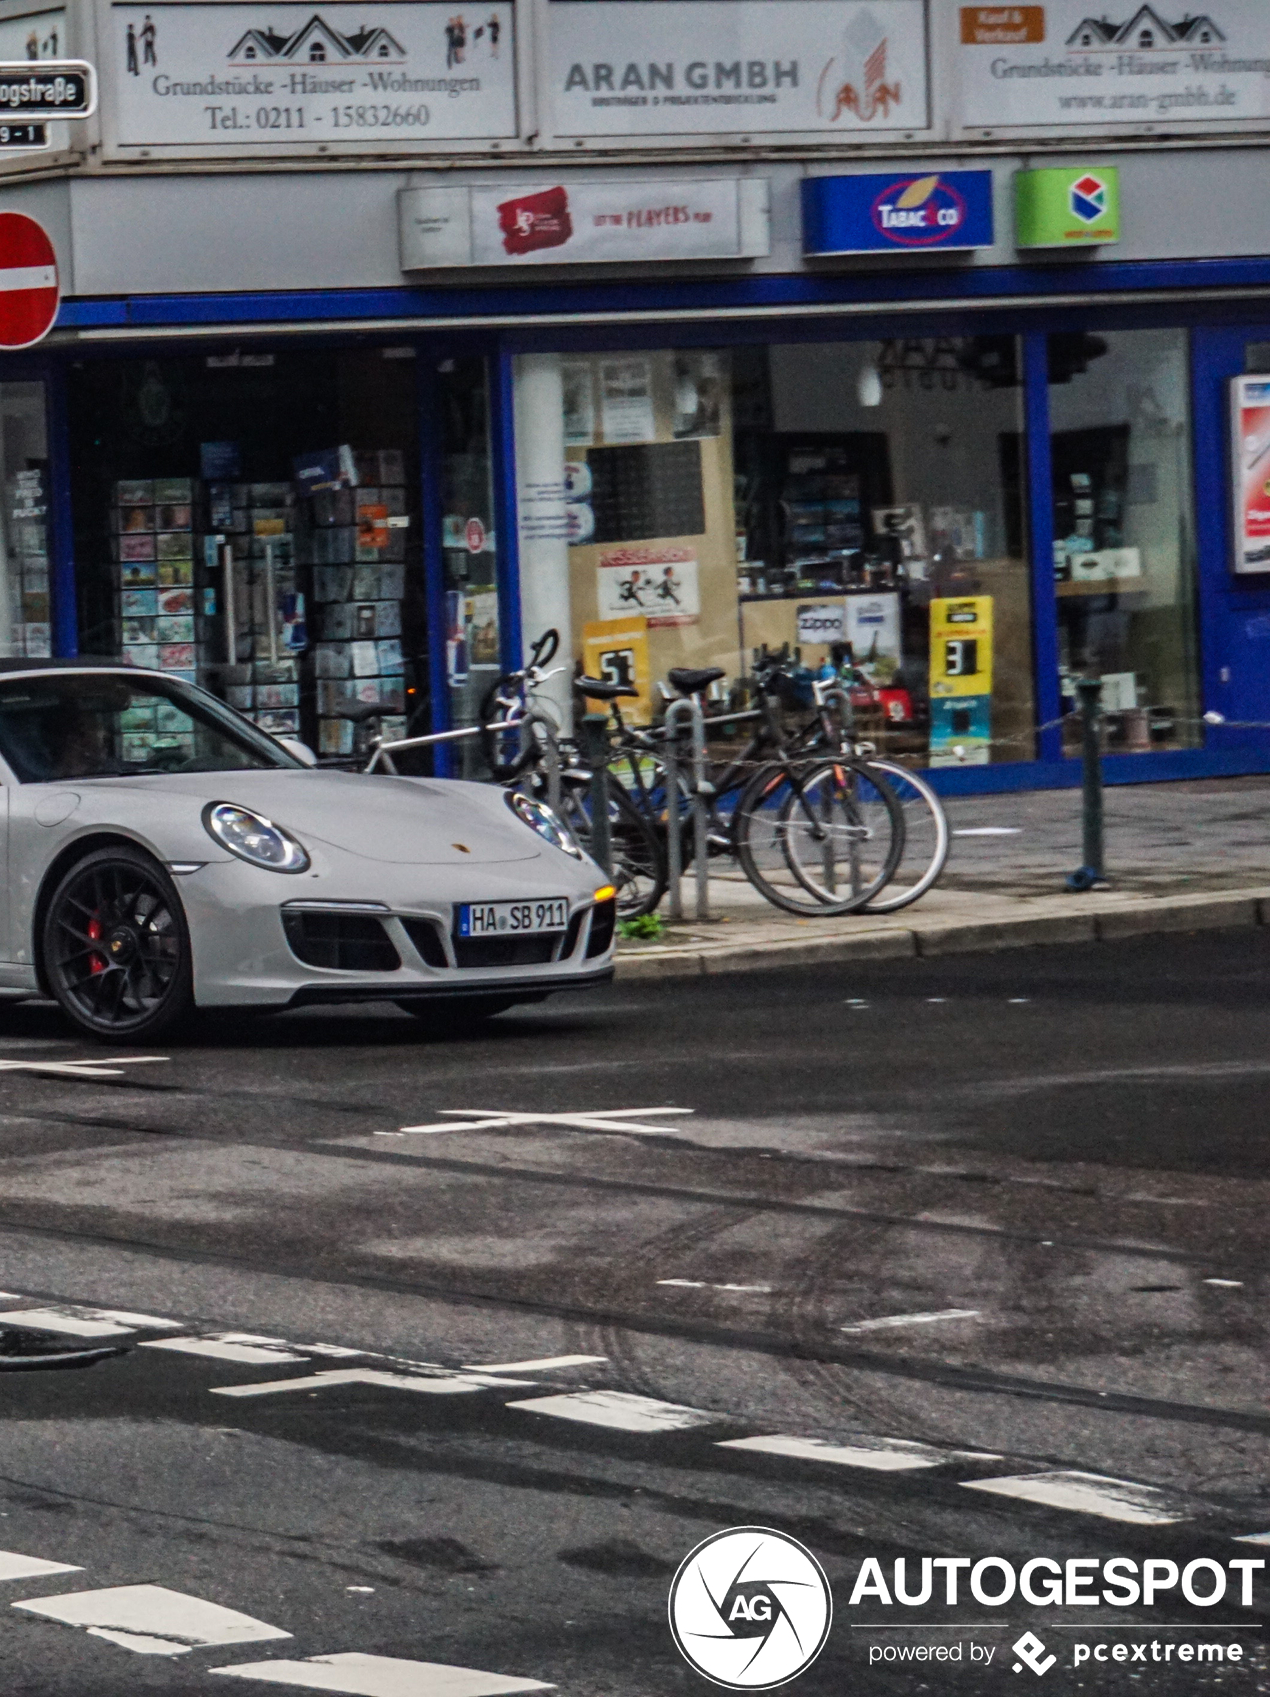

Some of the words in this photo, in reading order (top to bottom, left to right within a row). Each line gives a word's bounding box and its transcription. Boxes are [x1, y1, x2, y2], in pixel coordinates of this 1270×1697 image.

[153, 73, 273, 97] Grundstücke
[564, 62, 674, 92] ARAN
[684, 60, 799, 90] GMBH
[205, 106, 250, 130] Tel.:
[256, 105, 305, 129] 0211
[332, 104, 430, 128] 15832660
[627, 205, 690, 229] PLAYERS
[472, 906, 497, 931] HA
[510, 905, 532, 929] SB
[536, 902, 565, 928] 911
